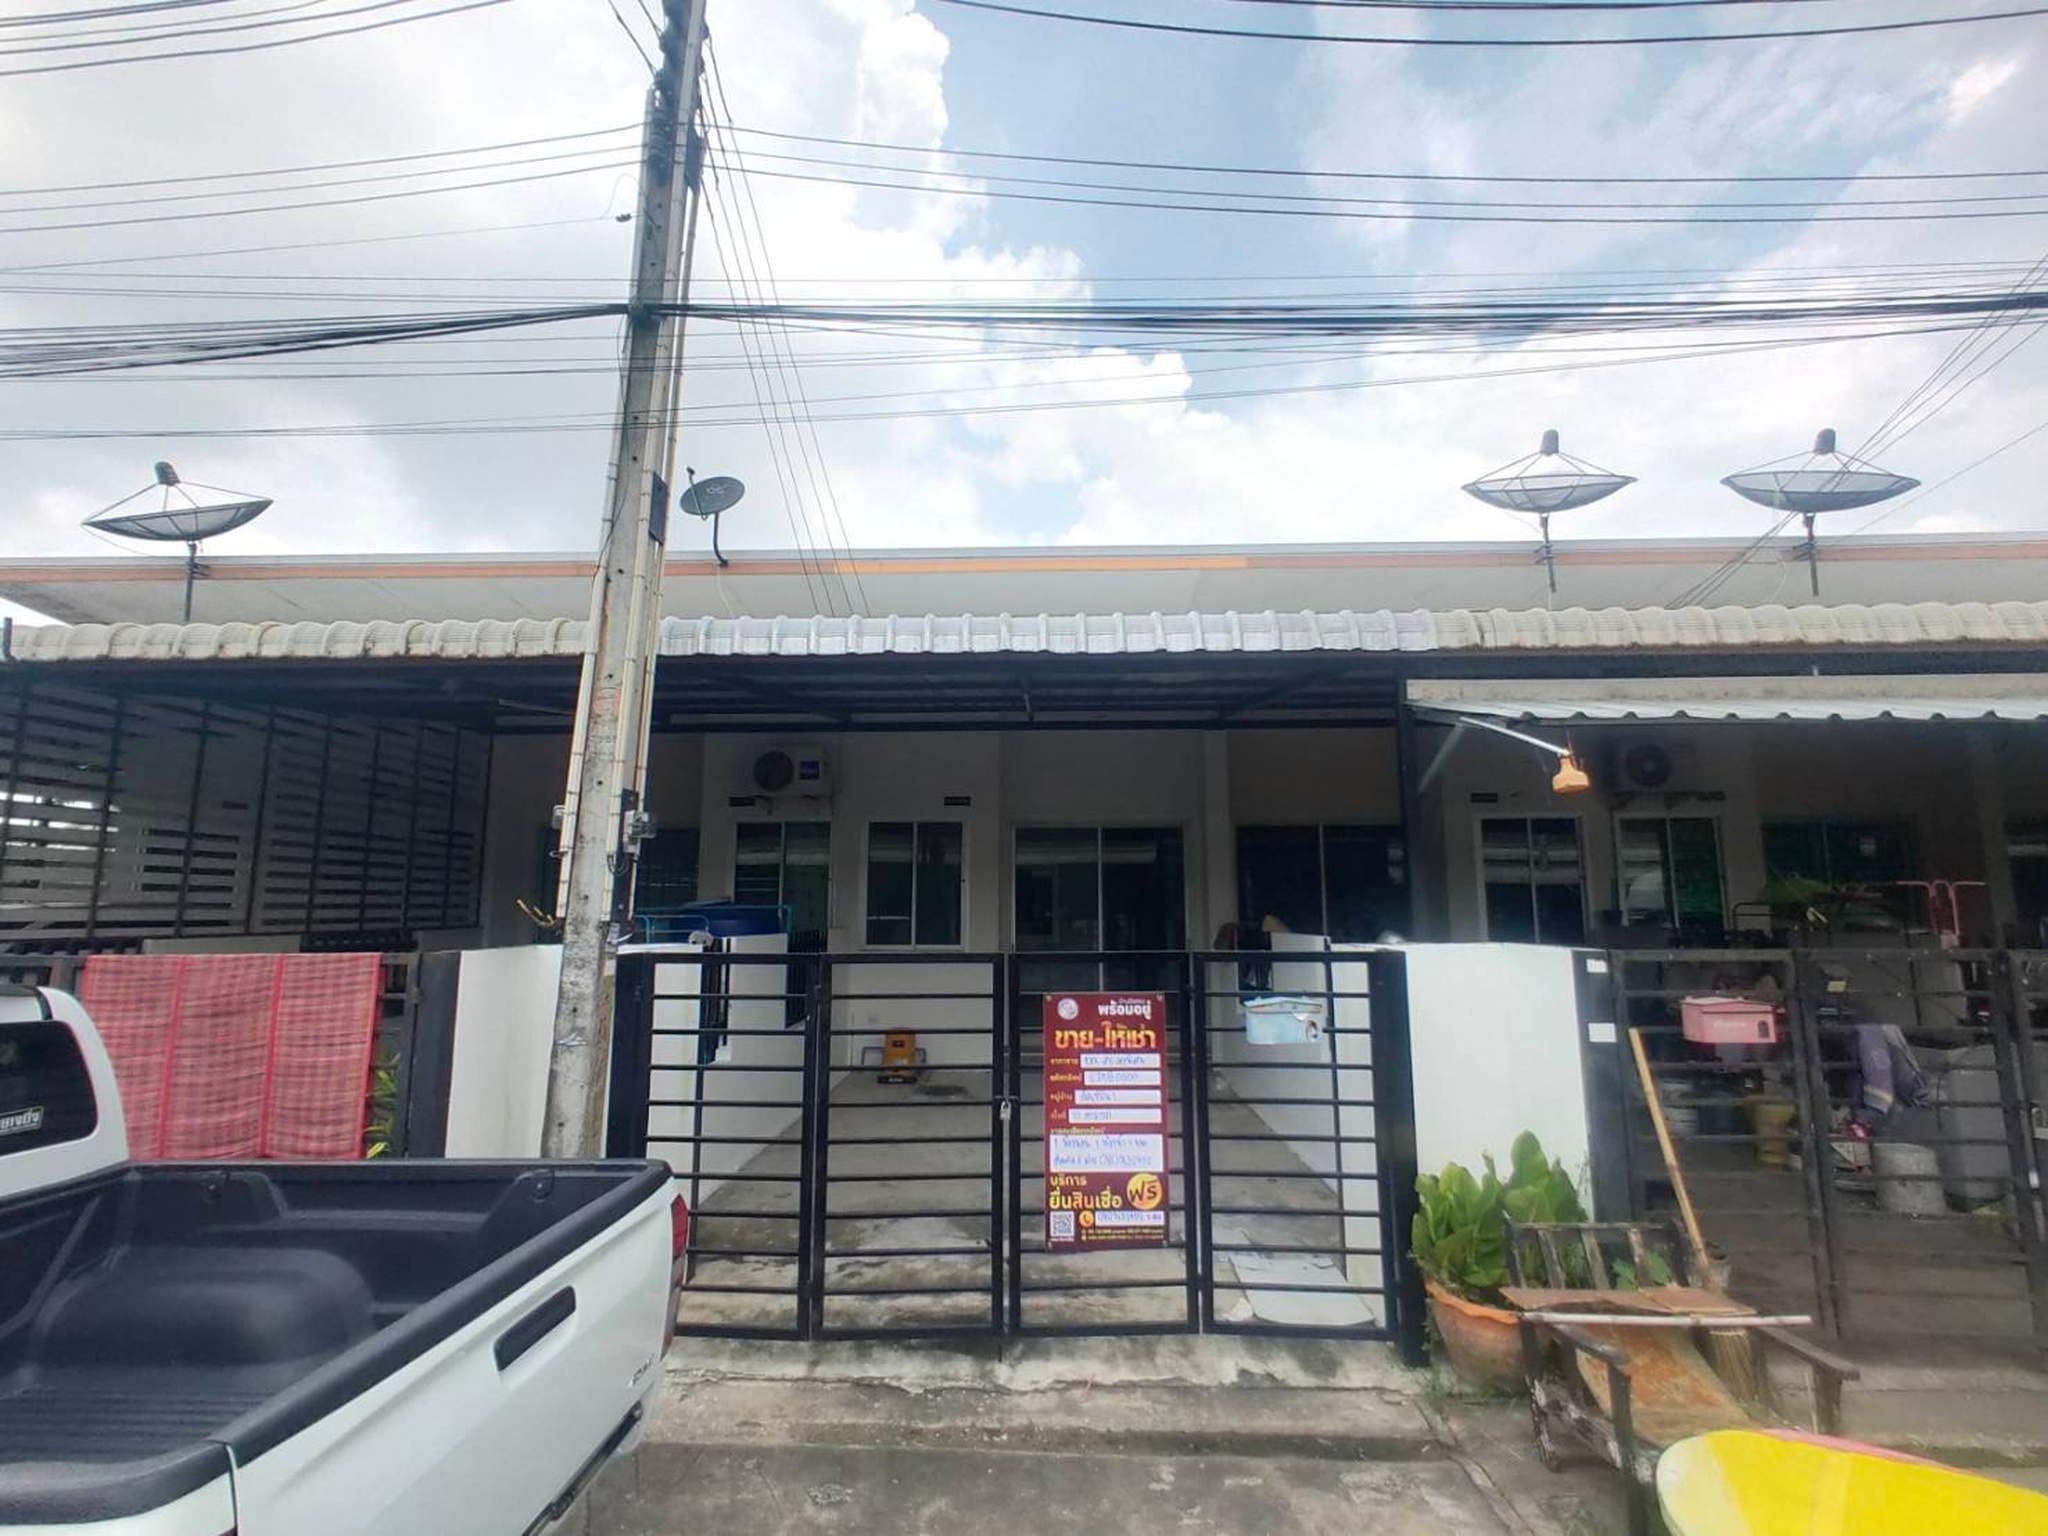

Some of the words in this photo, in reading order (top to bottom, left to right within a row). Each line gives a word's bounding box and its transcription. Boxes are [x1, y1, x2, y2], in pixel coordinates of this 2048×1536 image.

[1098, 999, 1151, 1020] พร้อมอยู่
[1050, 1173, 1087, 1187] บริการ
[1129, 1176, 1158, 1203] ฟรี
[1049, 1186, 1122, 1209] ยื่นสินเชื่อ
